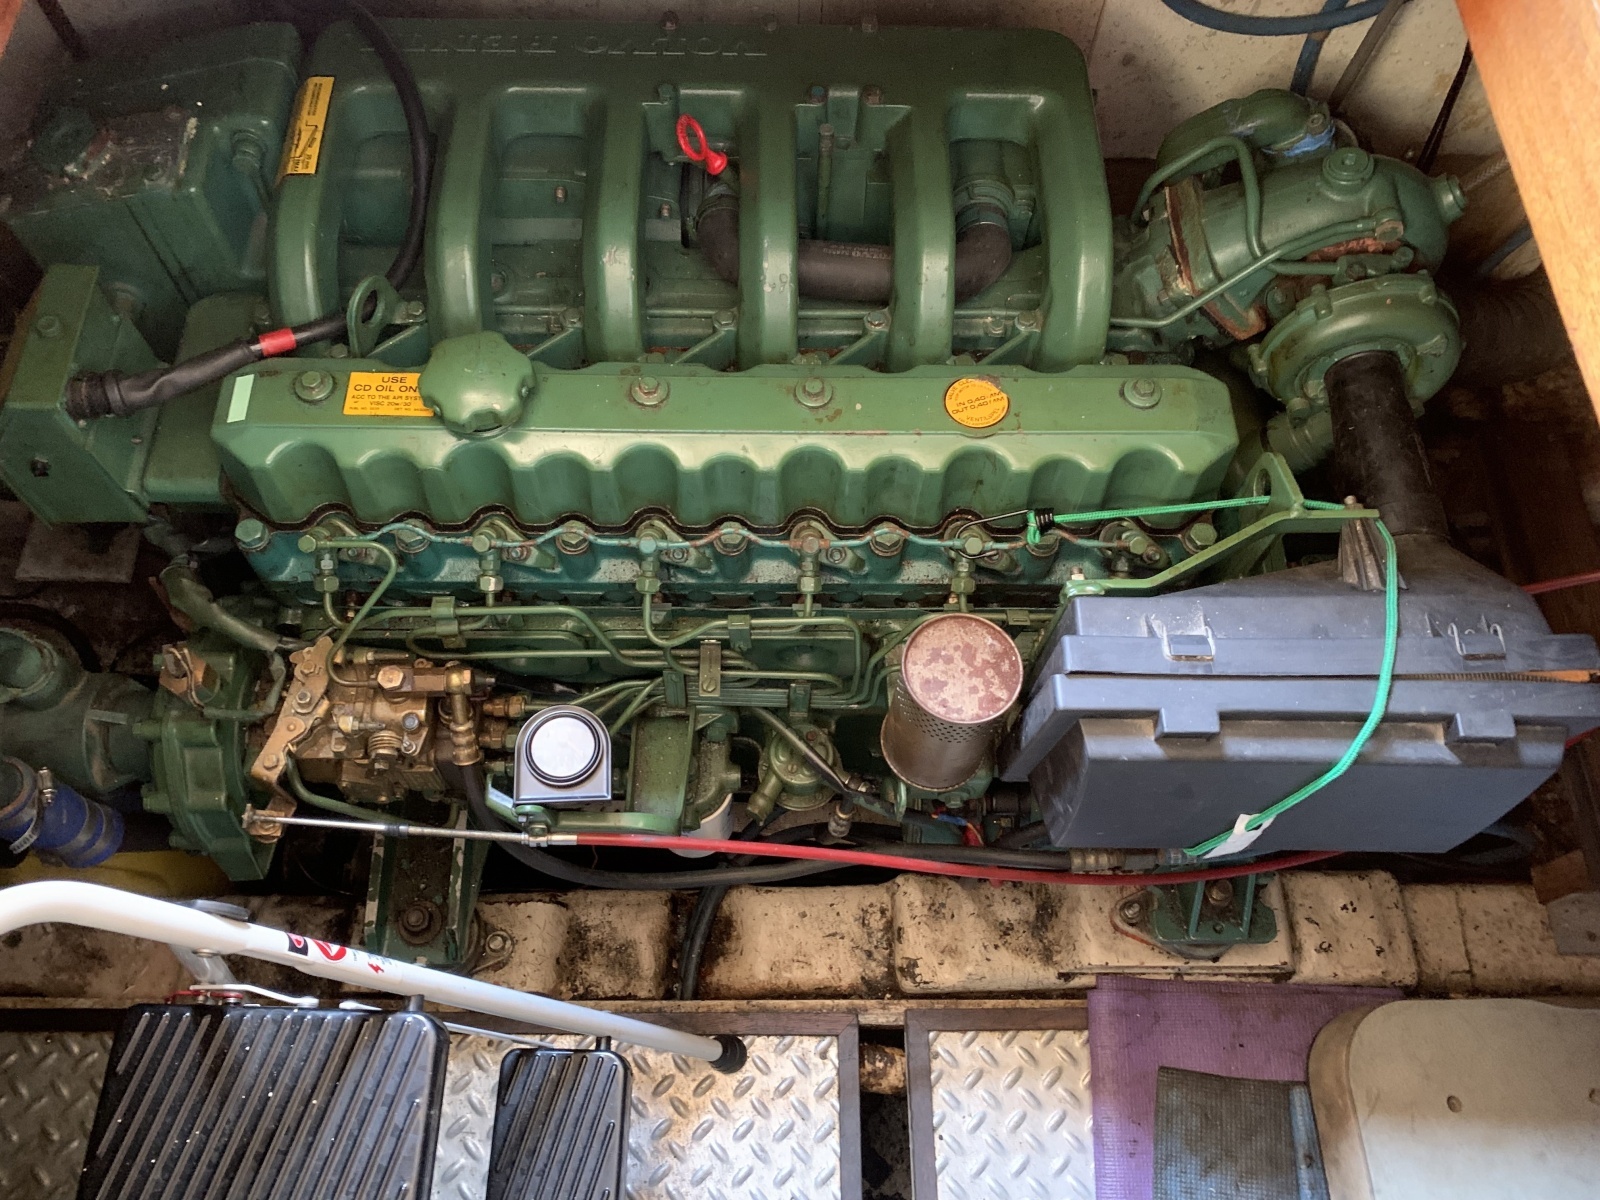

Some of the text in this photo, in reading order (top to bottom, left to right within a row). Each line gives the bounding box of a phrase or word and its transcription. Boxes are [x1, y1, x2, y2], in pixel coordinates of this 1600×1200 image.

[572, 33, 769, 56] VOLVO
[381, 376, 408, 384] USE
[353, 384, 418, 393] CD OIL ON
